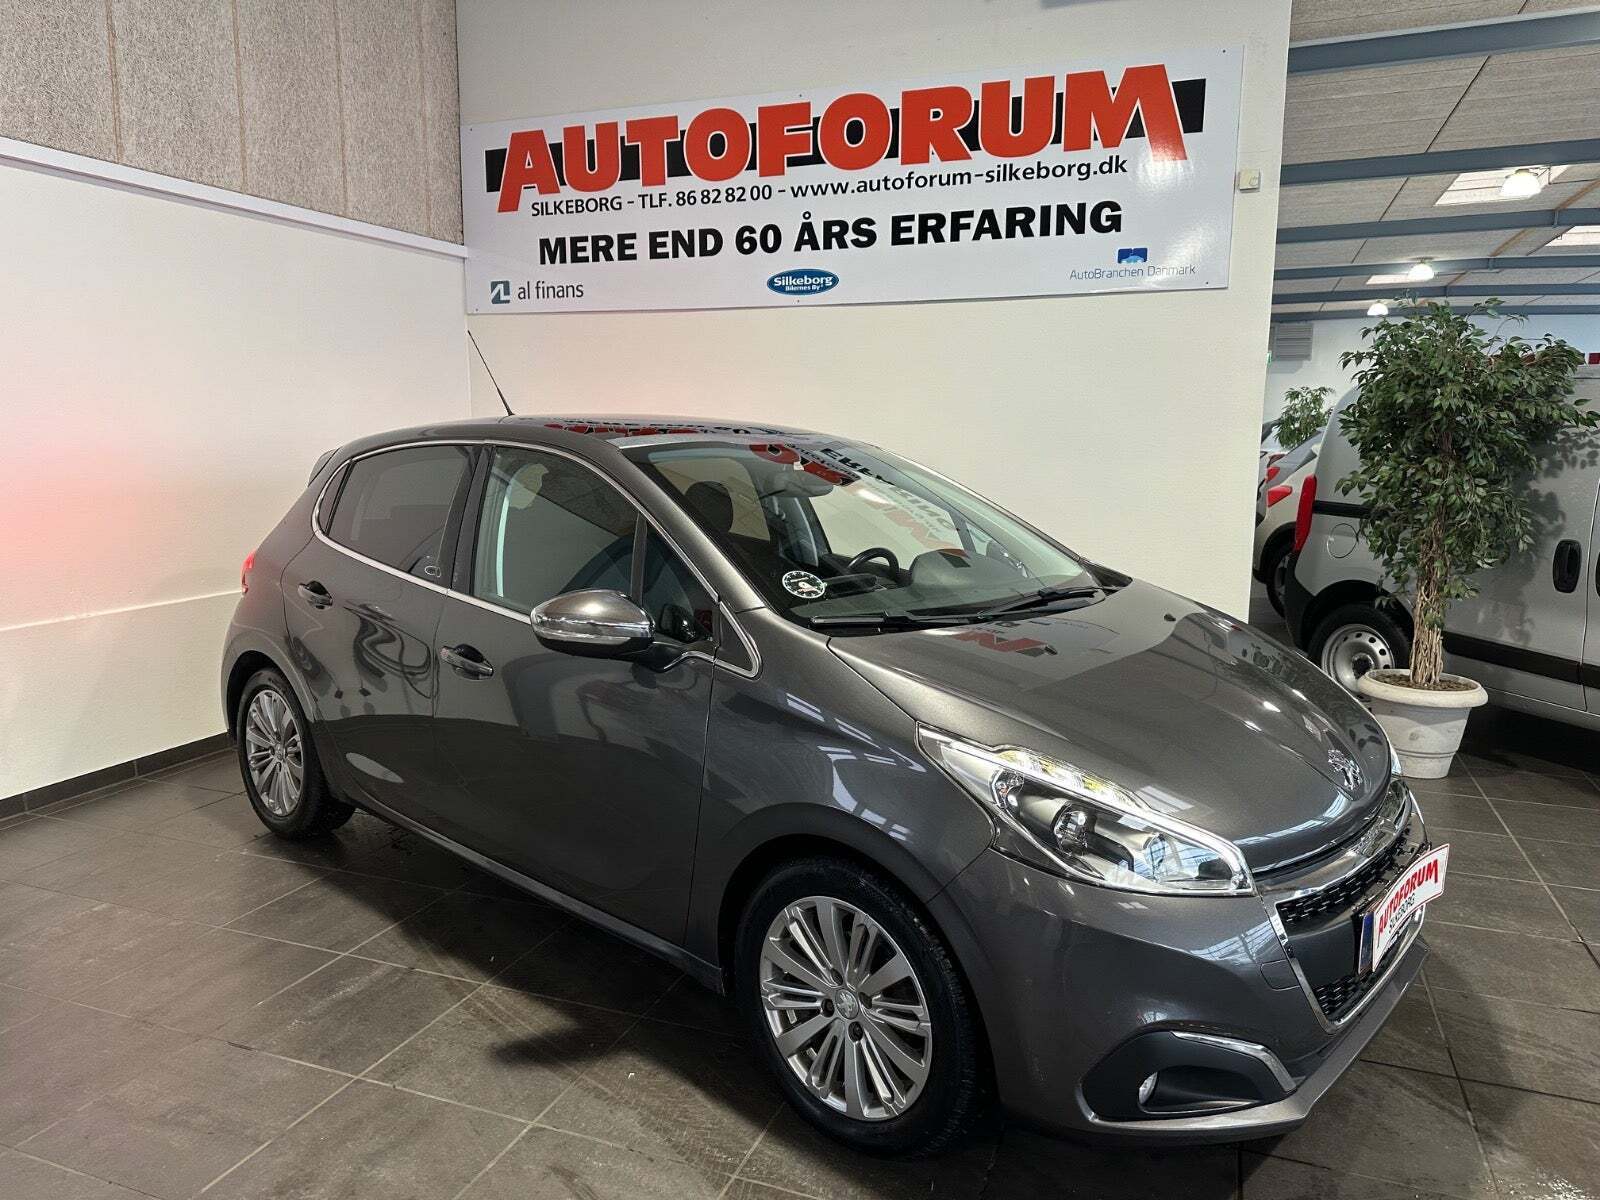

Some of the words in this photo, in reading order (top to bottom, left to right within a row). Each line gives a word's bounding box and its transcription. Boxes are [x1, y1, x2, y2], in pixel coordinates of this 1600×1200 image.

[498, 64, 1186, 212] AUTOFORUM
[532, 196, 622, 217] SILKEBORG
[638, 194, 671, 209] TLF.
[790, 155, 1128, 198] www.autoforum-silkeborg.dk
[539, 233, 637, 265] MERE
[649, 228, 723, 259] END
[736, 224, 781, 255] 60
[794, 211, 877, 251] ÅRS
[891, 200, 1122, 247] ERFARING
[518, 281, 531, 299] al
[535, 280, 584, 299] finans
[773, 275, 833, 286] Silkeborg
[1070, 268, 1144, 280] AutoBranchen
[1148, 264, 1196, 276] Danmark
[1379, 859, 1438, 933] AUTOFORUM
